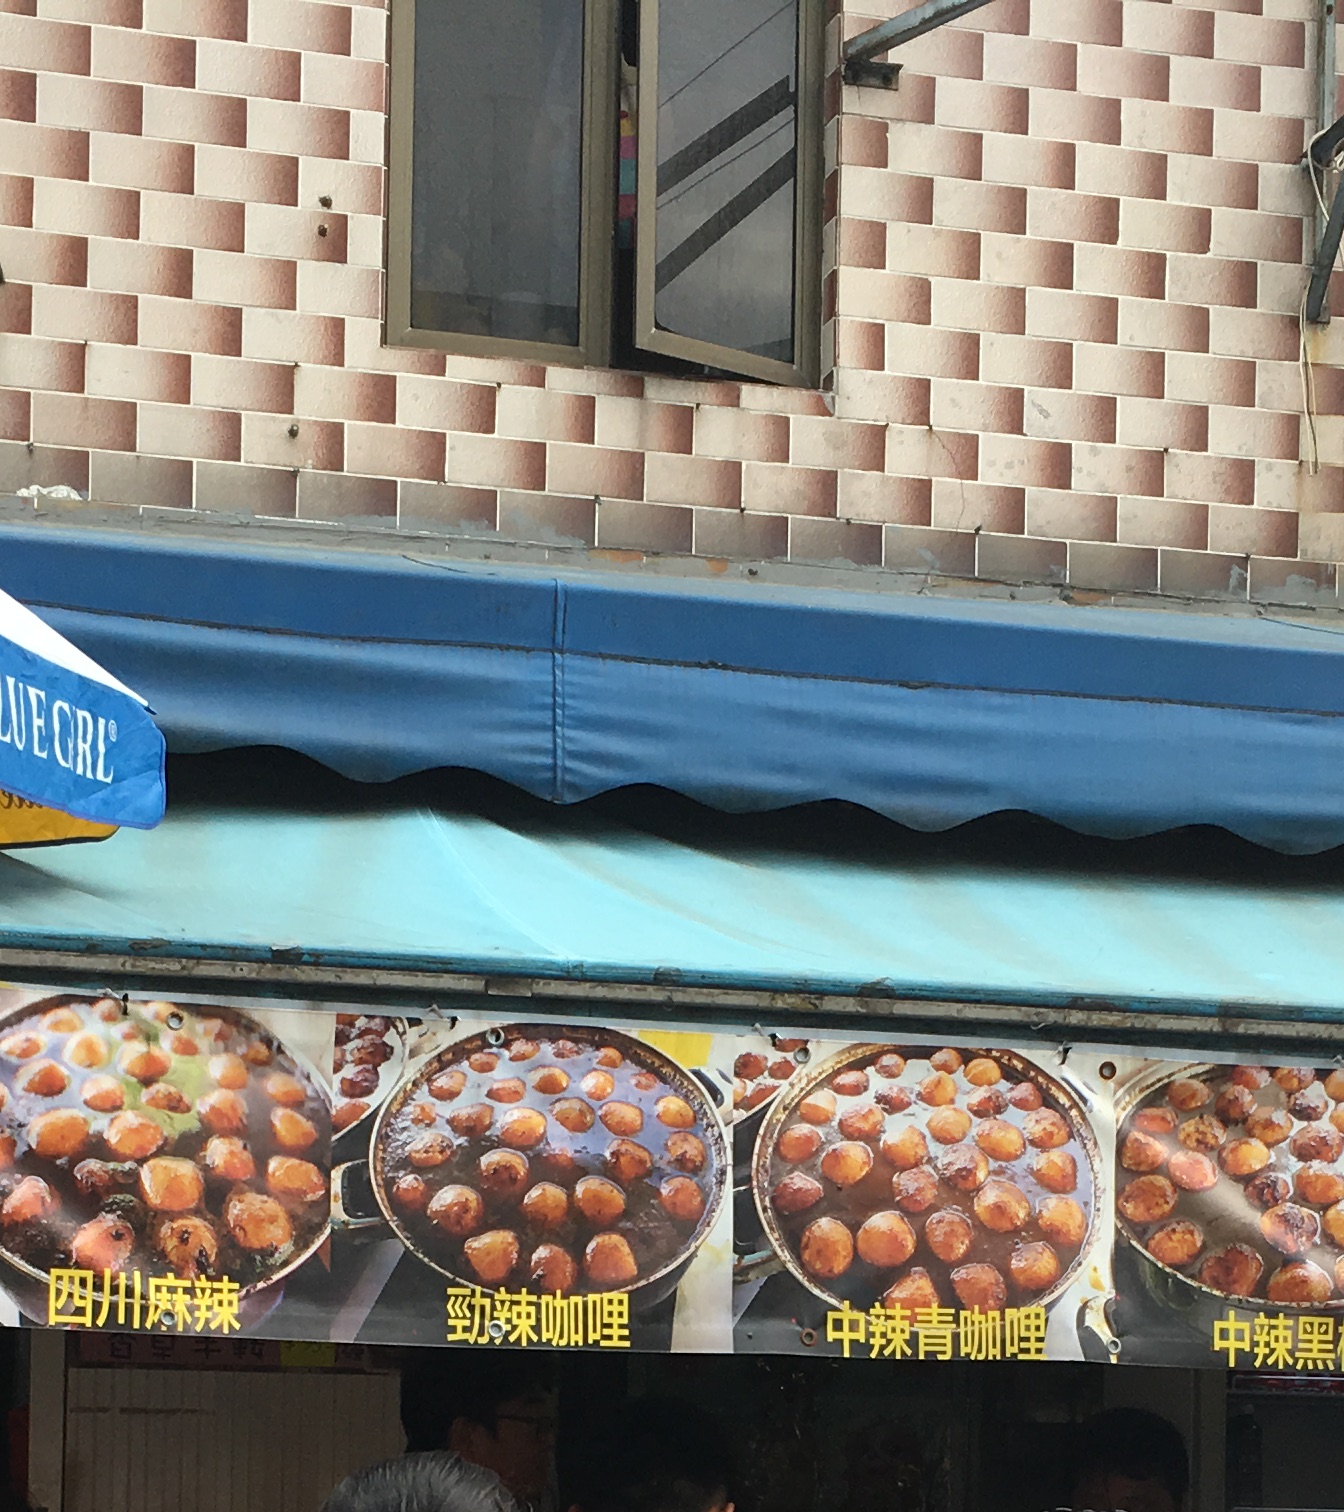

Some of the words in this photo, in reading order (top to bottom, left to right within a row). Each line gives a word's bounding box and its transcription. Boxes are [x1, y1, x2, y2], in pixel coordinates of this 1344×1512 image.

[47, 1265, 243, 1335] 四川麻辣
[445, 1284, 632, 1350] 勁辣咖哩
[825, 1299, 1050, 1363] 中辣青咖哩
